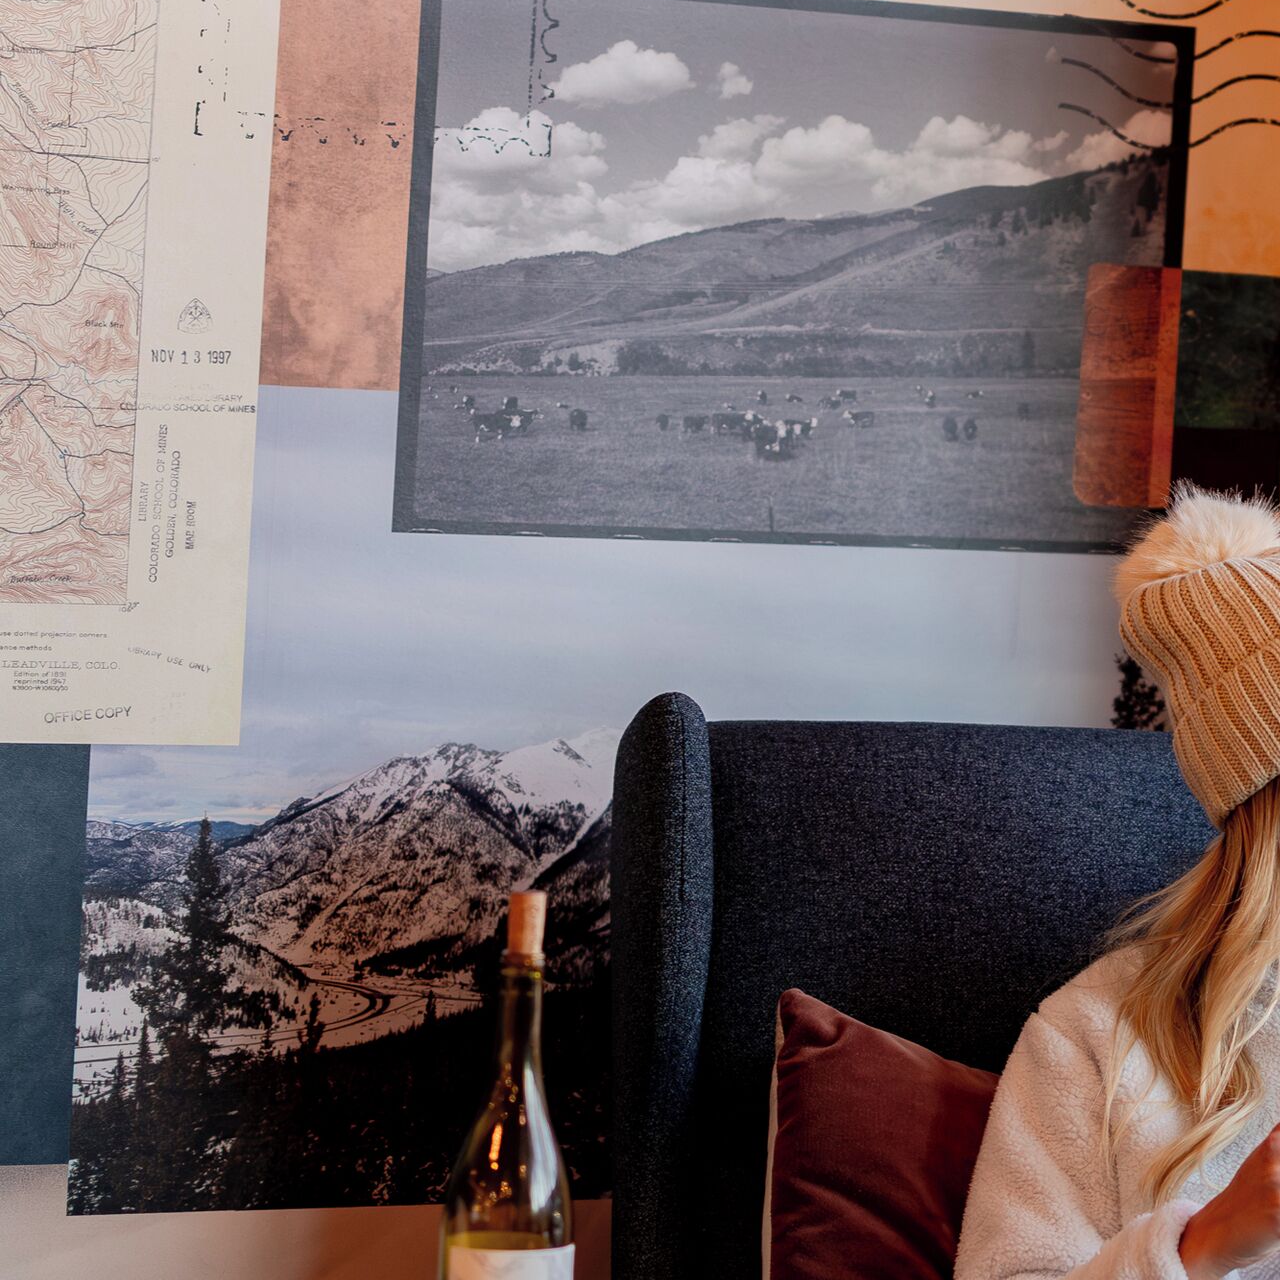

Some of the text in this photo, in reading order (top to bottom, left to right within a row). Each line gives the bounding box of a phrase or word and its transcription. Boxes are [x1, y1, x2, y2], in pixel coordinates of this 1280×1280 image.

[151, 349, 175, 363] NOV
[207, 350, 232, 365] 1997
[173, 404, 211, 412] SCHOOL
[228, 405, 256, 414] MINES
[169, 450, 181, 509] COLORADO
[138, 481, 149, 522] LIBRARY
[149, 423, 168, 583] COLORADO SCHOOL OF MINES
[186, 501, 197, 527] ROOM
[40, 630, 77, 639] projection
[1, 660, 121, 671] LEADVILLE, COLO.
[167, 656, 184, 666] USE
[44, 705, 132, 724] OFFICE COPY
